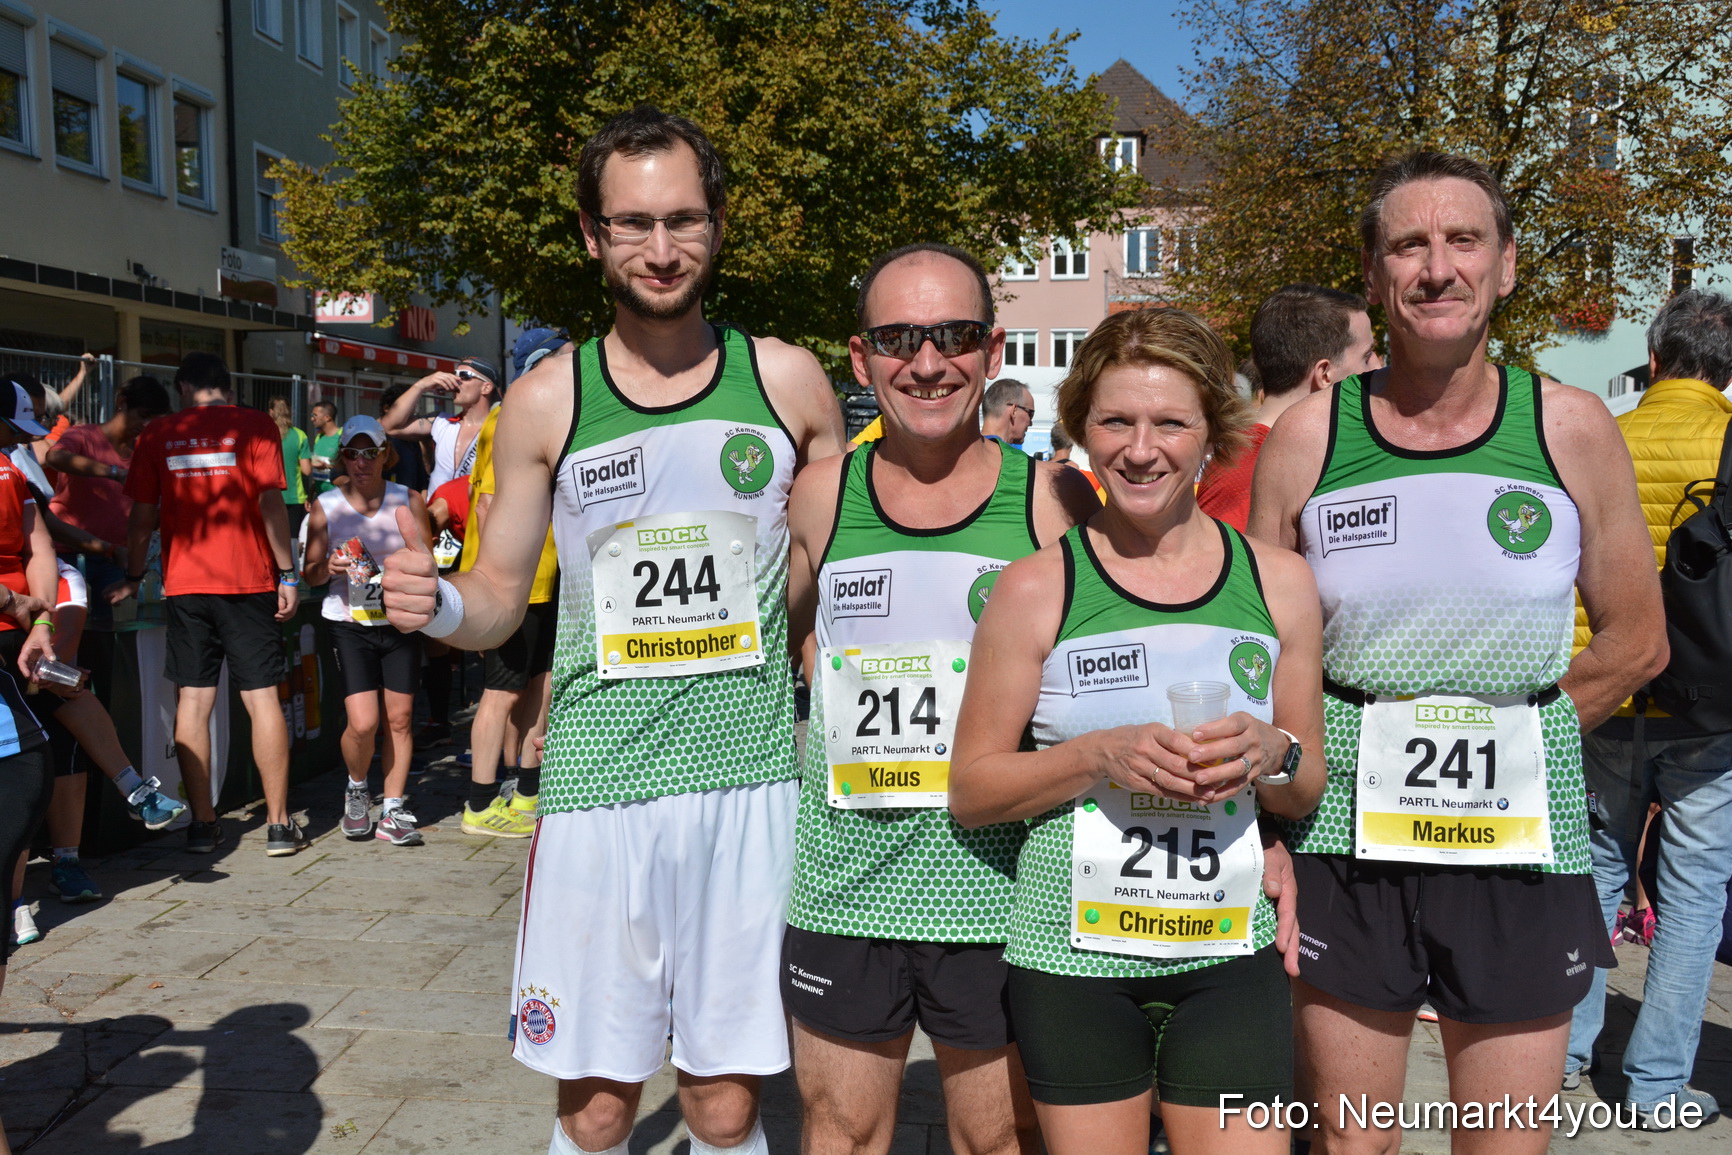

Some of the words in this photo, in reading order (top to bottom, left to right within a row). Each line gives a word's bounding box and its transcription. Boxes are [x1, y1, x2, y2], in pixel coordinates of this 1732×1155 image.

[221, 247, 242, 270] Foto
[407, 306, 436, 342] NKD
[724, 429, 734, 438] SC
[735, 427, 767, 440] Kemmern
[583, 491, 593, 499] Die
[595, 480, 637, 496] Halspastille
[733, 490, 765, 500] RUNNING
[1494, 485, 1506, 496] SC
[1507, 483, 1544, 500] Kemmern
[637, 525, 709, 546] BOCK
[1328, 534, 1340, 544] Die
[1342, 530, 1388, 543] Halspastille
[1501, 549, 1538, 561] RUNNING
[977, 565, 987, 574] SC
[633, 555, 721, 608] 244
[605, 600, 612, 609] A
[841, 602, 882, 611] Halspastille
[632, 616, 665, 626] PARTL
[667, 612, 715, 624] Neumarkt
[626, 633, 737, 658] Christopher
[1230, 637, 1240, 646] SC
[1240, 635, 1269, 650] Kemmern
[861, 655, 932, 675] BOCK
[1079, 679, 1091, 687] Die
[1093, 674, 1140, 686] Halspastille
[856, 687, 940, 737] 214
[1415, 704, 1494, 724] BOCK
[832, 731, 837, 739] A
[851, 746, 881, 756] PARTL
[883, 744, 930, 755] Neumarkt
[1404, 737, 1496, 790] 241
[869, 767, 921, 787] Klaus
[1369, 775, 1376, 785] C
[1399, 796, 1438, 808] PARTL
[1441, 799, 1493, 809] Neumarkt
[1186, 813, 1211, 821] concepts
[1412, 820, 1495, 844] Markus
[1119, 826, 1220, 882] 215
[1084, 865, 1091, 874] B
[1114, 887, 1153, 899] PARTL
[1156, 889, 1210, 901] Neumarkt
[1119, 910, 1214, 936] Christine
[789, 963, 798, 974] SC
[798, 968, 833, 986] Kemmern
[1565, 962, 1587, 977] erima
[791, 978, 824, 996] RUNNING
[530, 1001, 555, 1024] BAYERN
